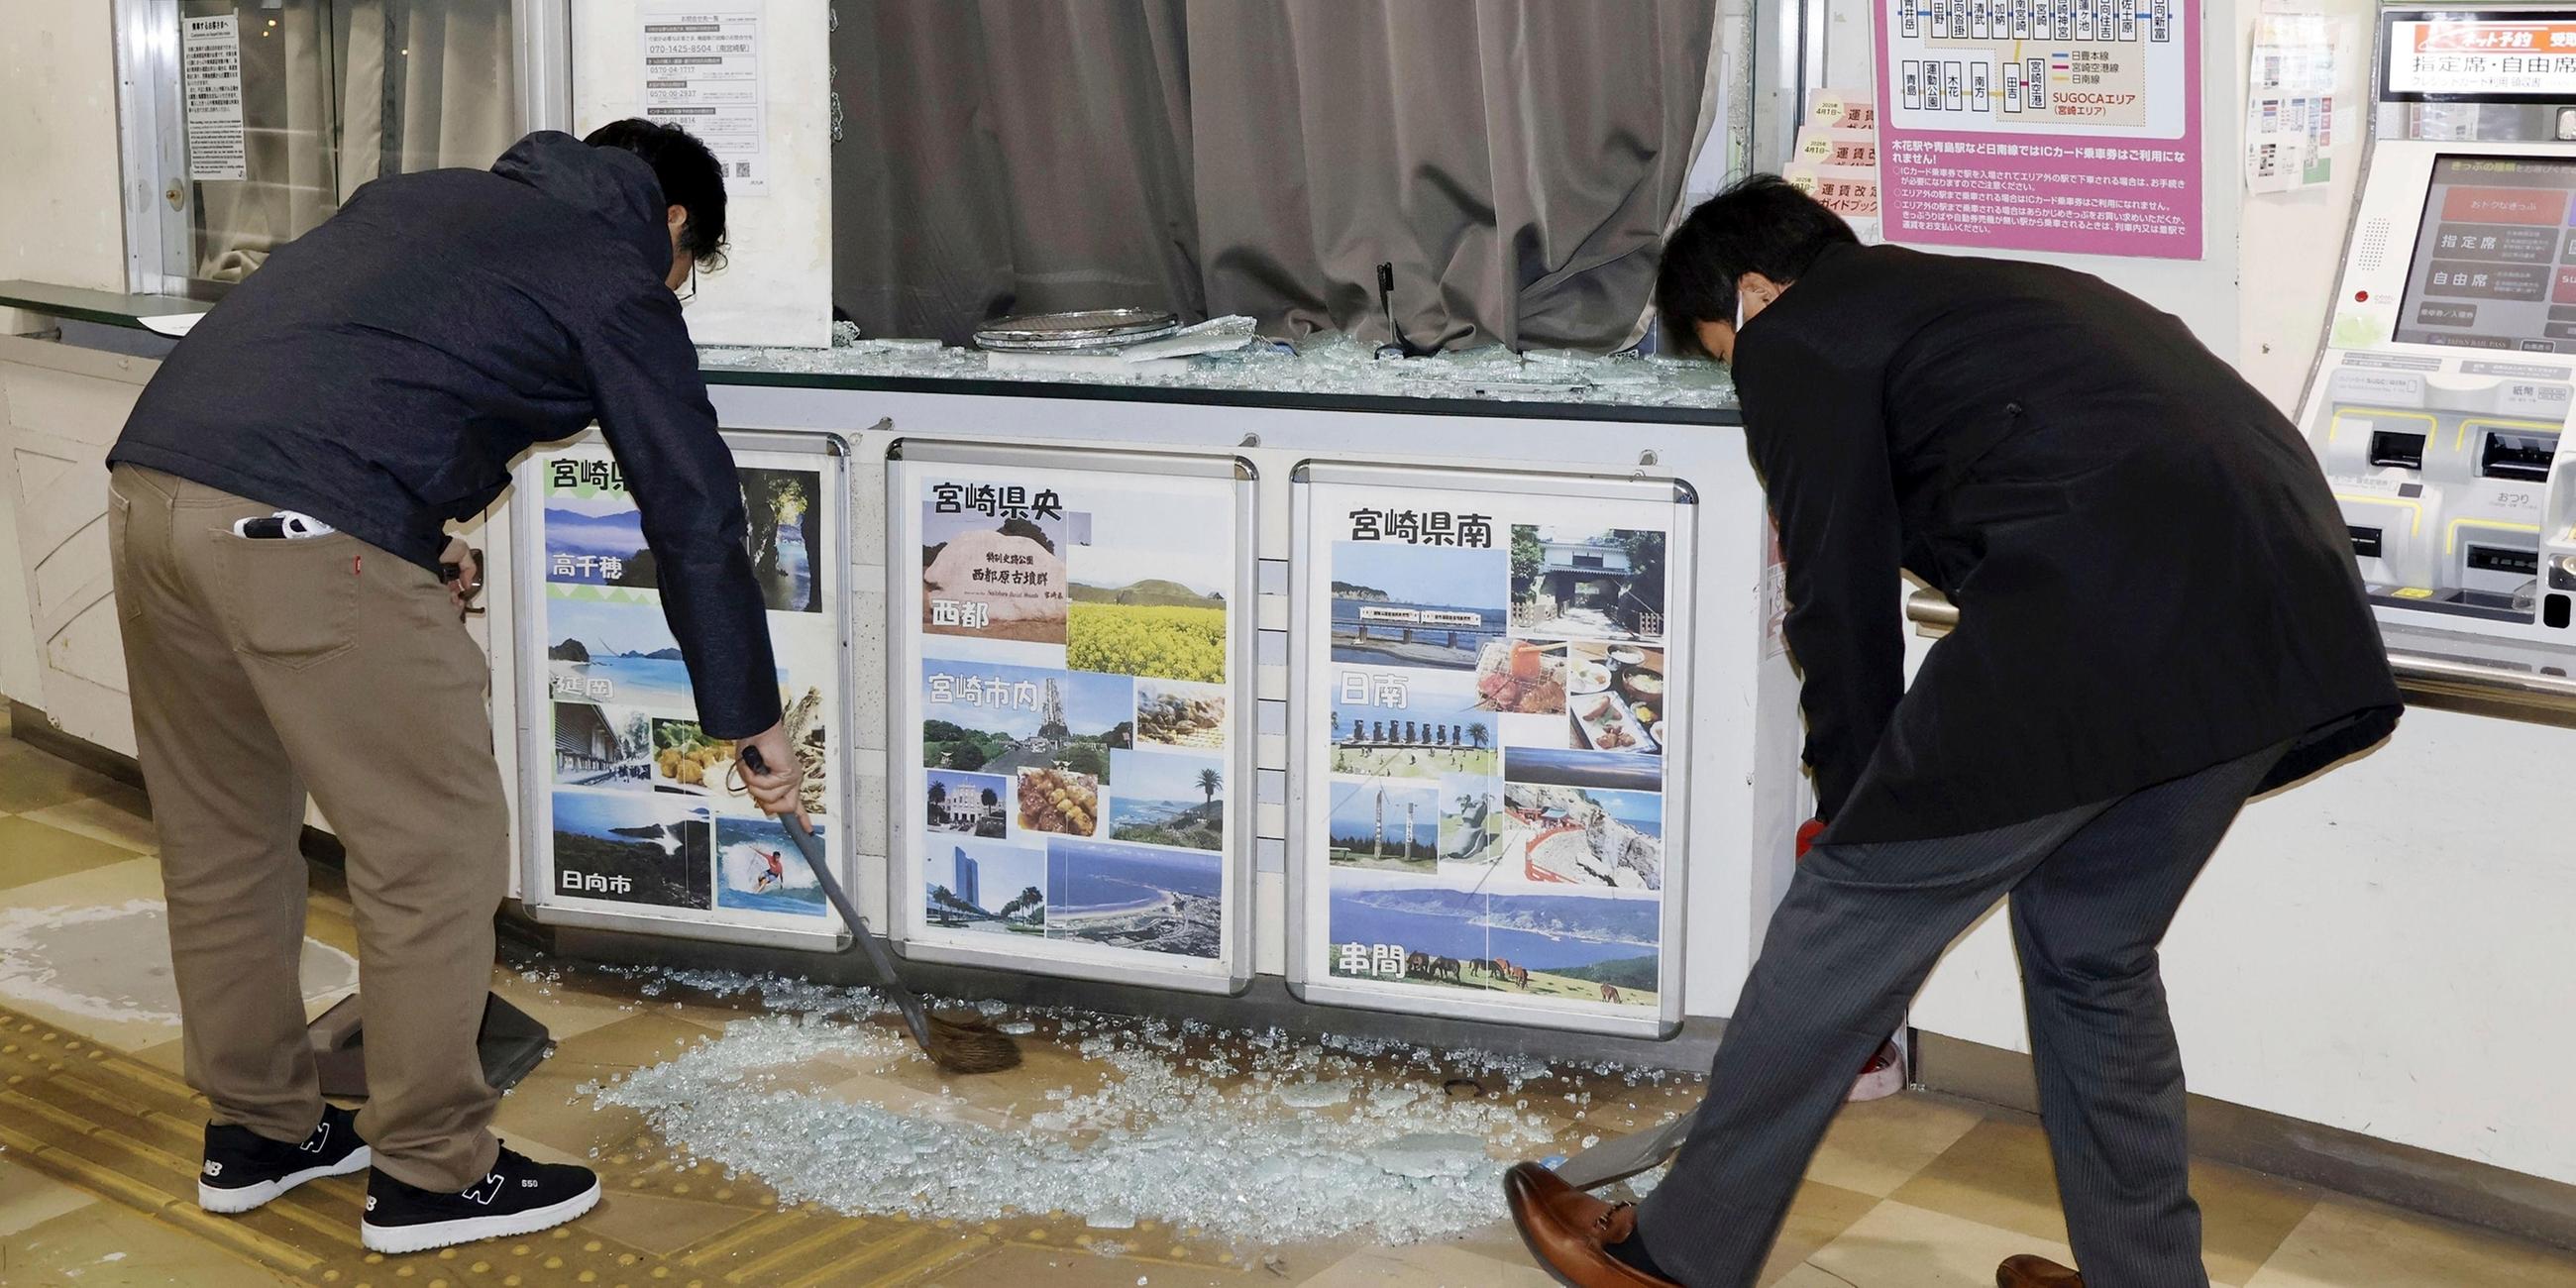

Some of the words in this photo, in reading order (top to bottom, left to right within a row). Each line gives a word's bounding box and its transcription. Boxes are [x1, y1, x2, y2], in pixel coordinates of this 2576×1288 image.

[1934, 3, 1944, 25] 田野
[1974, 3, 1986, 26] 清武
[1994, 4, 2005, 26] 加納
[2036, 4, 2047, 26] 宮崎
[2057, 0, 2069, 39] 崎神宮
[2072, 51, 2109, 61] 日豊本線
[2072, 62, 2119, 73] 宮崎空港線
[1906, 74, 1917, 96] 青島
[1926, 63, 1938, 108] 運動公園
[1948, 75, 1959, 98] 木花
[1975, 76, 1986, 98] 南方
[2006, 77, 2017, 99] 田吉
[2031, 61, 2042, 106] 宮崎空港
[2072, 74, 2100, 84] 日南線
[2053, 92, 2136, 105] SUGOCAエリア
[2440, 235, 2497, 250] 指定席
[2433, 271, 2488, 287] 自由席
[932, 482, 1063, 522] 宮崎県央
[2497, 491, 2529, 503] おつり
[1348, 507, 1493, 549] 宮崎県南
[553, 553, 623, 581] 高千穂
[972, 568, 1048, 587] 西都原古墳群
[930, 597, 990, 630] 西都
[927, 673, 1039, 713] 宮崎市内
[1340, 669, 1409, 709] 日南
[562, 870, 633, 895] 日向市
[1339, 941, 1407, 979] 串間
